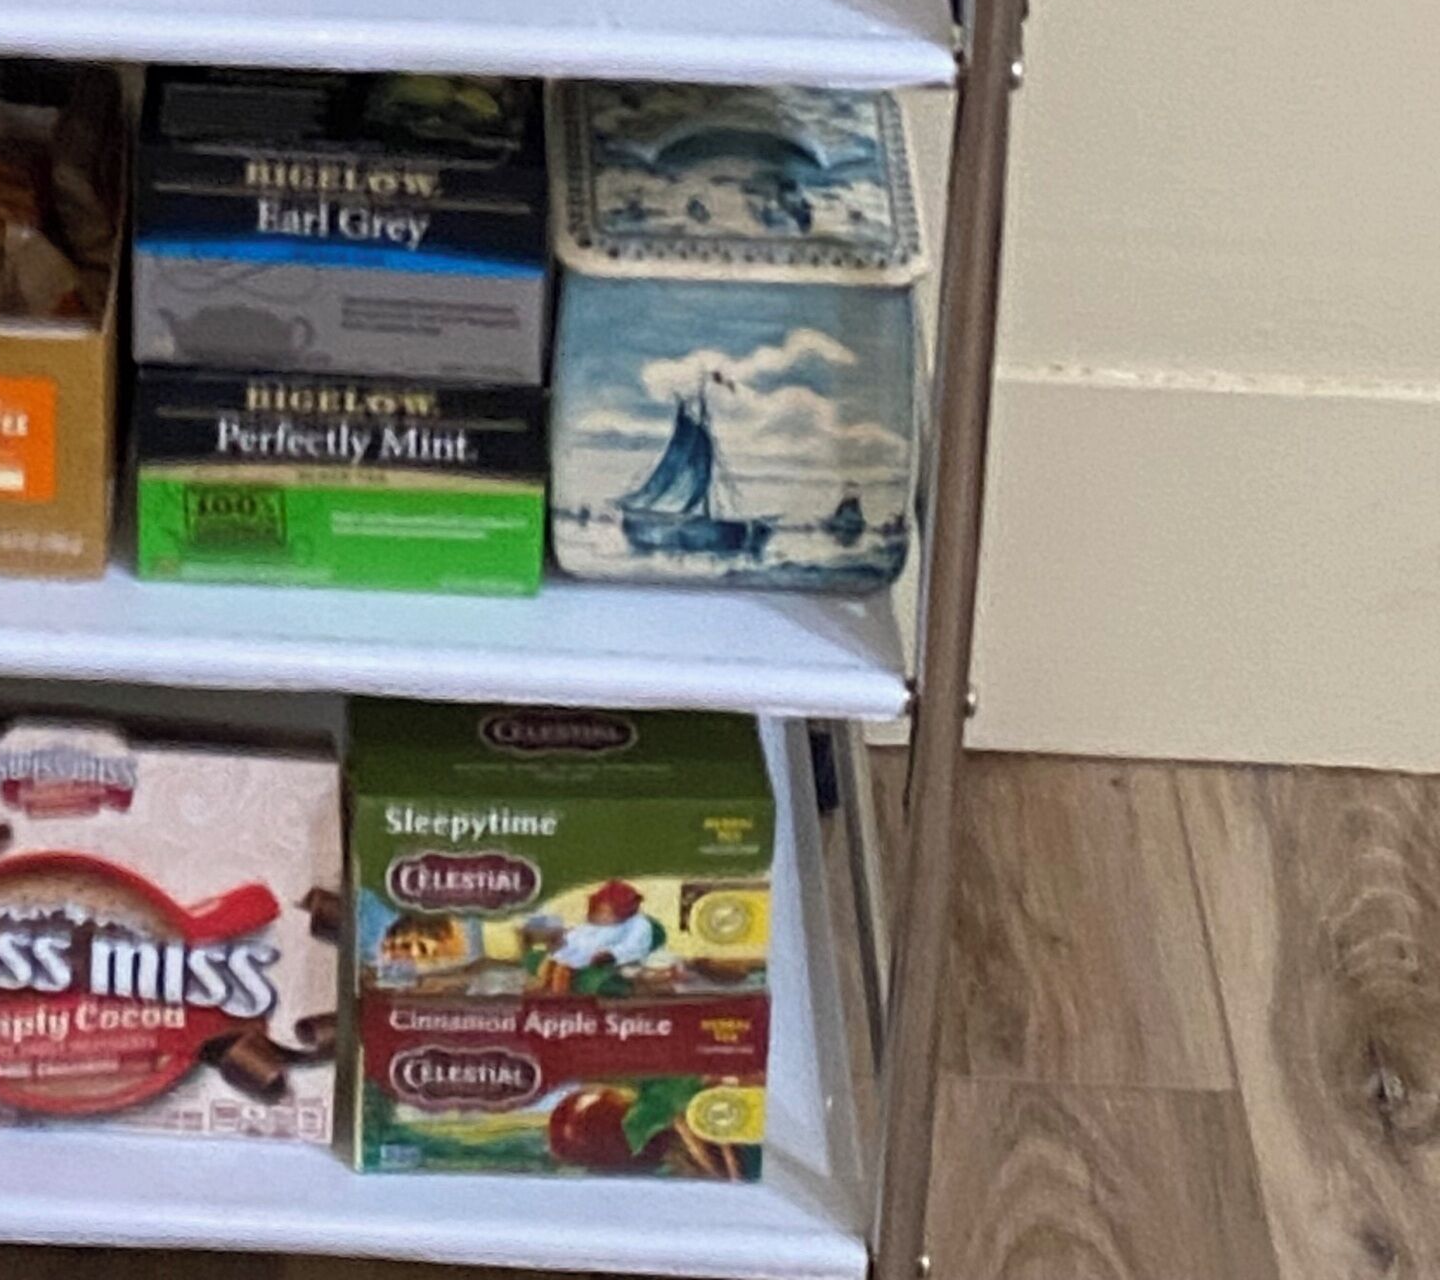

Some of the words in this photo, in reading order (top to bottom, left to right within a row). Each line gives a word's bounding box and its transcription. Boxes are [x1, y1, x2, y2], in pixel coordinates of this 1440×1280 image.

[244, 159, 440, 199] BIGELOW
[257, 197, 329, 238] Earl
[338, 205, 429, 250] Grey
[246, 385, 437, 416] BIGELOW
[215, 415, 367, 464] Perfectly
[384, 803, 559, 843] Sleepytime
[74, 1000, 186, 1033] Cocoa
[389, 1008, 517, 1033] Cinnamon
[522, 1009, 598, 1041] Apple
[604, 1012, 673, 1042] Spice
